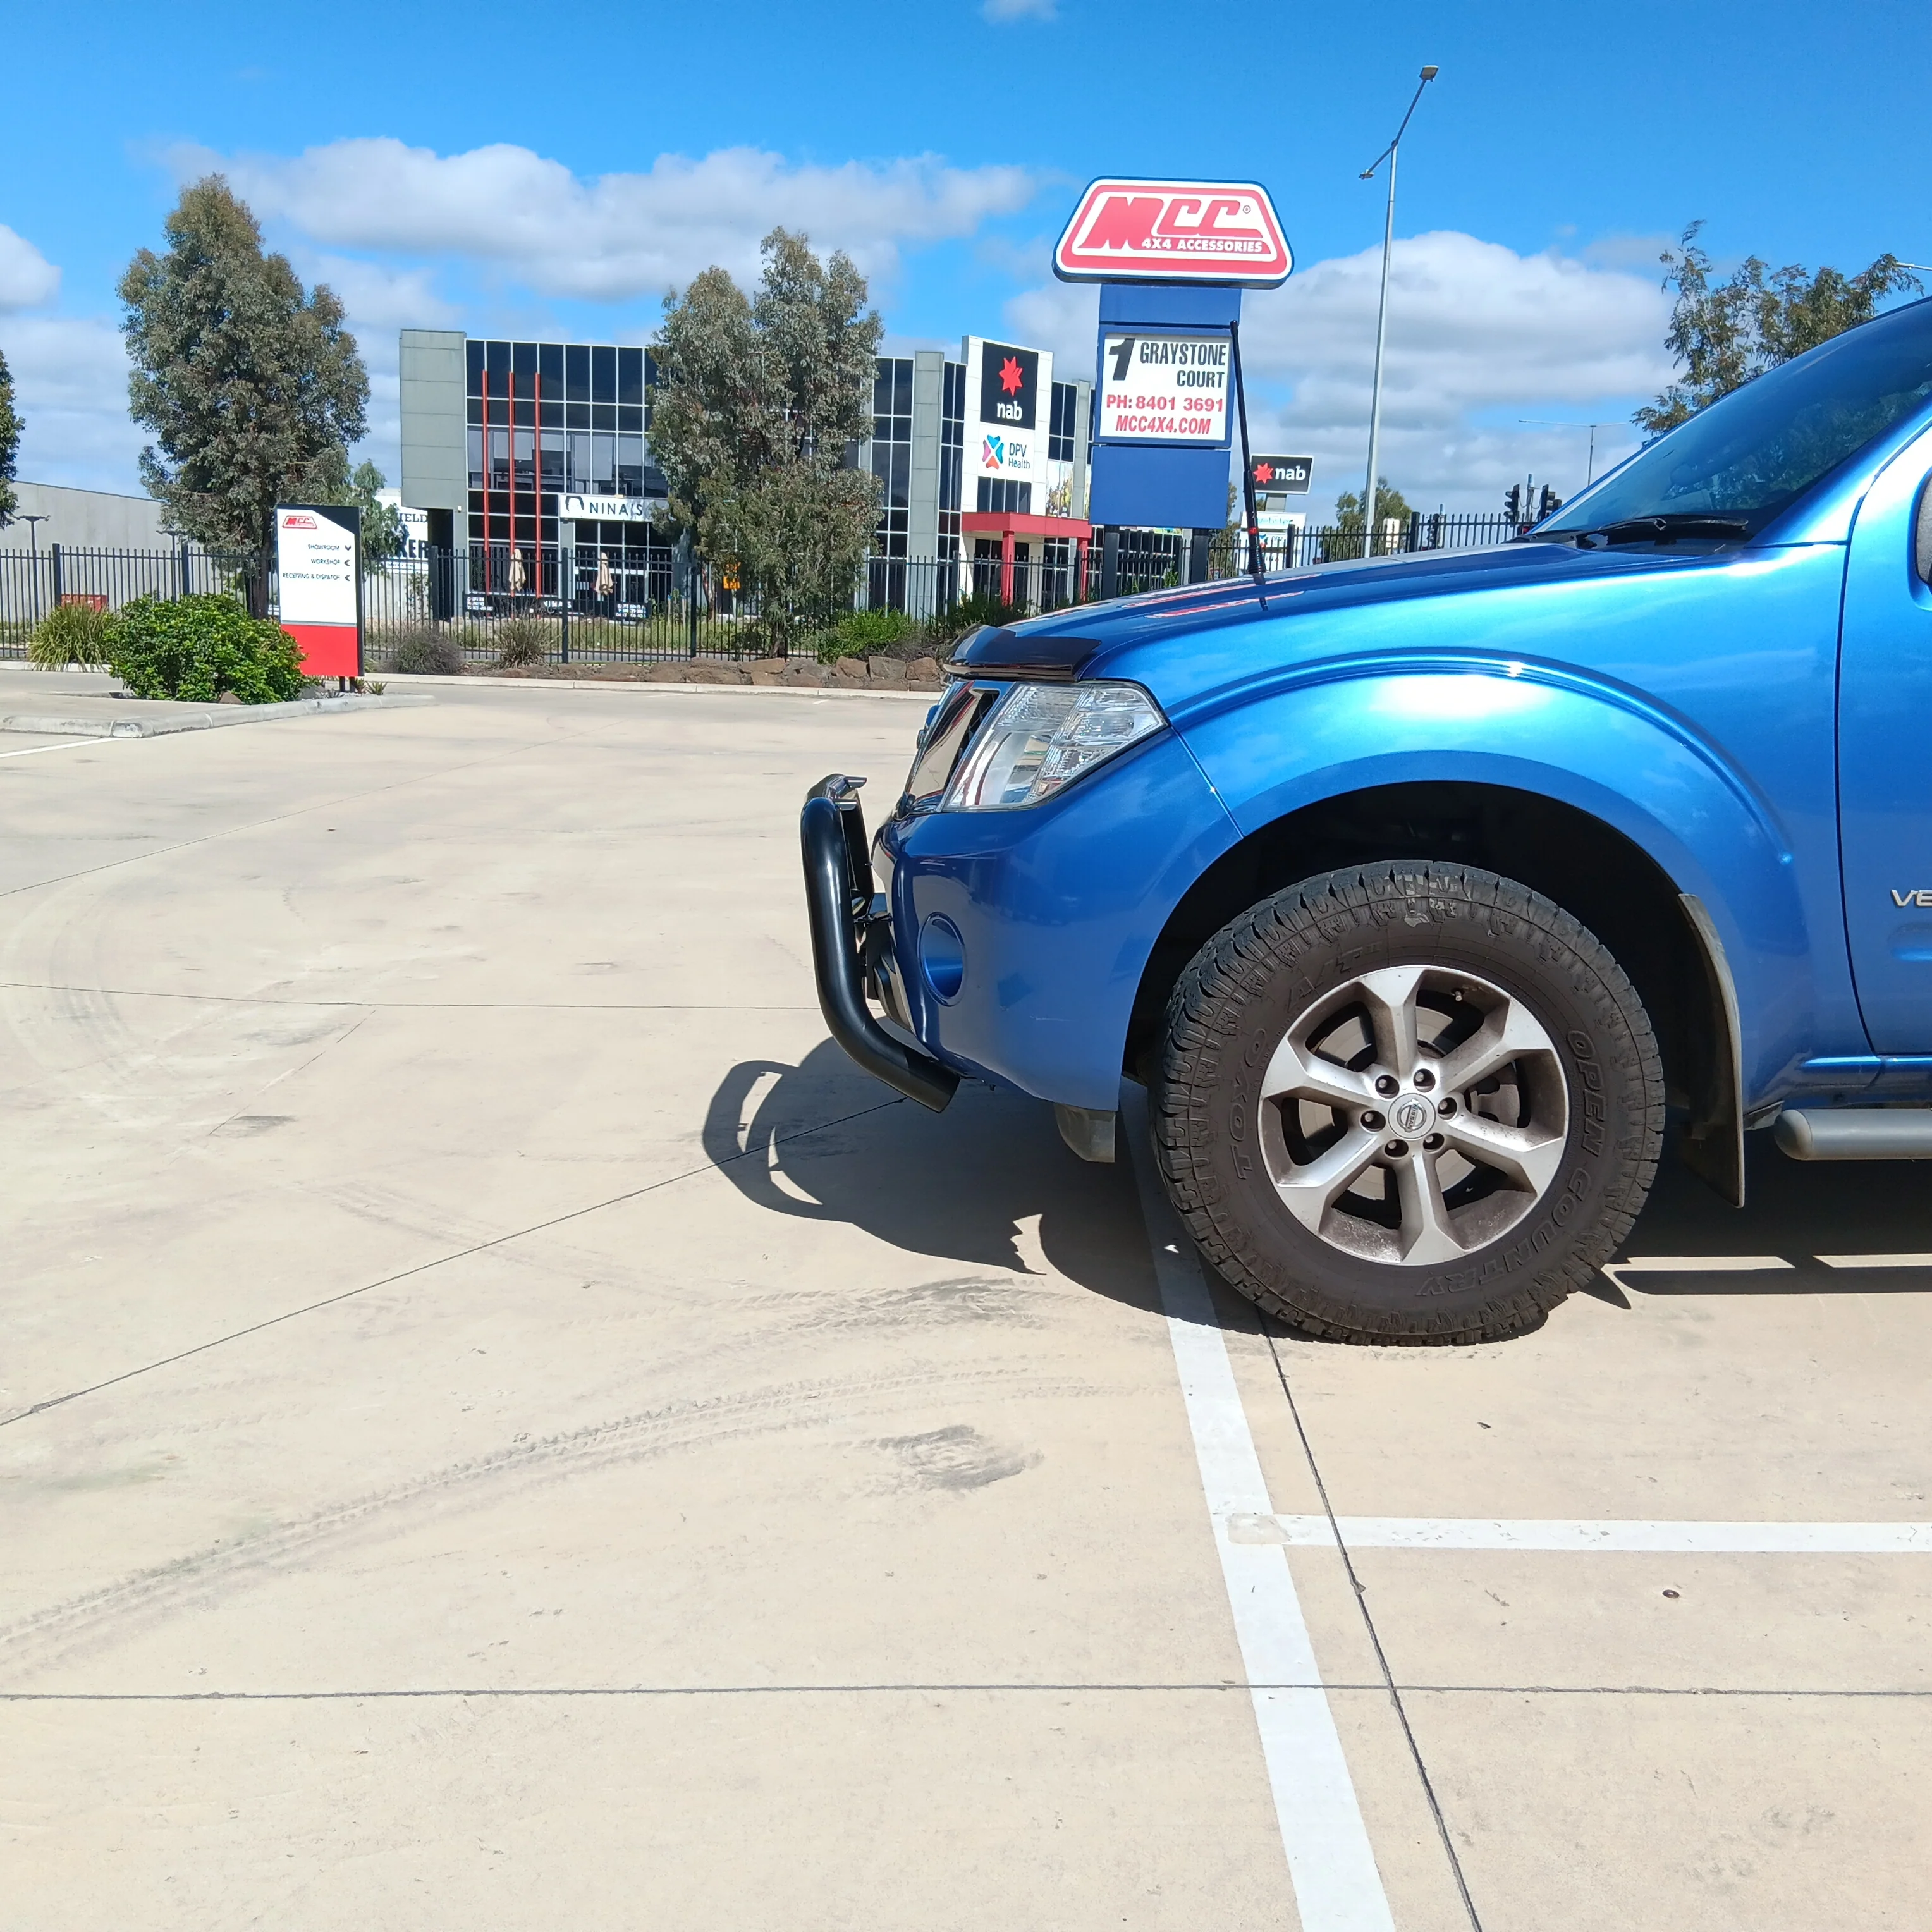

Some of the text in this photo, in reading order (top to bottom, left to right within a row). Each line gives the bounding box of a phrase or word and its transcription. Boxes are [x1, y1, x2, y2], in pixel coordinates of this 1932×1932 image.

[1077, 196, 1264, 250] MCC
[1141, 237, 1263, 253] 4X4 ACCESSORIES
[1108, 338, 1226, 381] 1 GRAYSTONE
[1176, 370, 1225, 388] COURT
[996, 400, 1023, 421] nab
[1106, 394, 1223, 412] PH: 8401 3691
[1115, 415, 1211, 434] MCC4X4.COM
[1008, 442, 1027, 457] DPV
[1008, 456, 1030, 470] Health
[1275, 465, 1306, 481] nab
[1230, 1028, 1266, 1180] TOYO
[1407, 1103, 1419, 1130] NISSAN
[1415, 1030, 1606, 1296] OPEN COUNTRY
